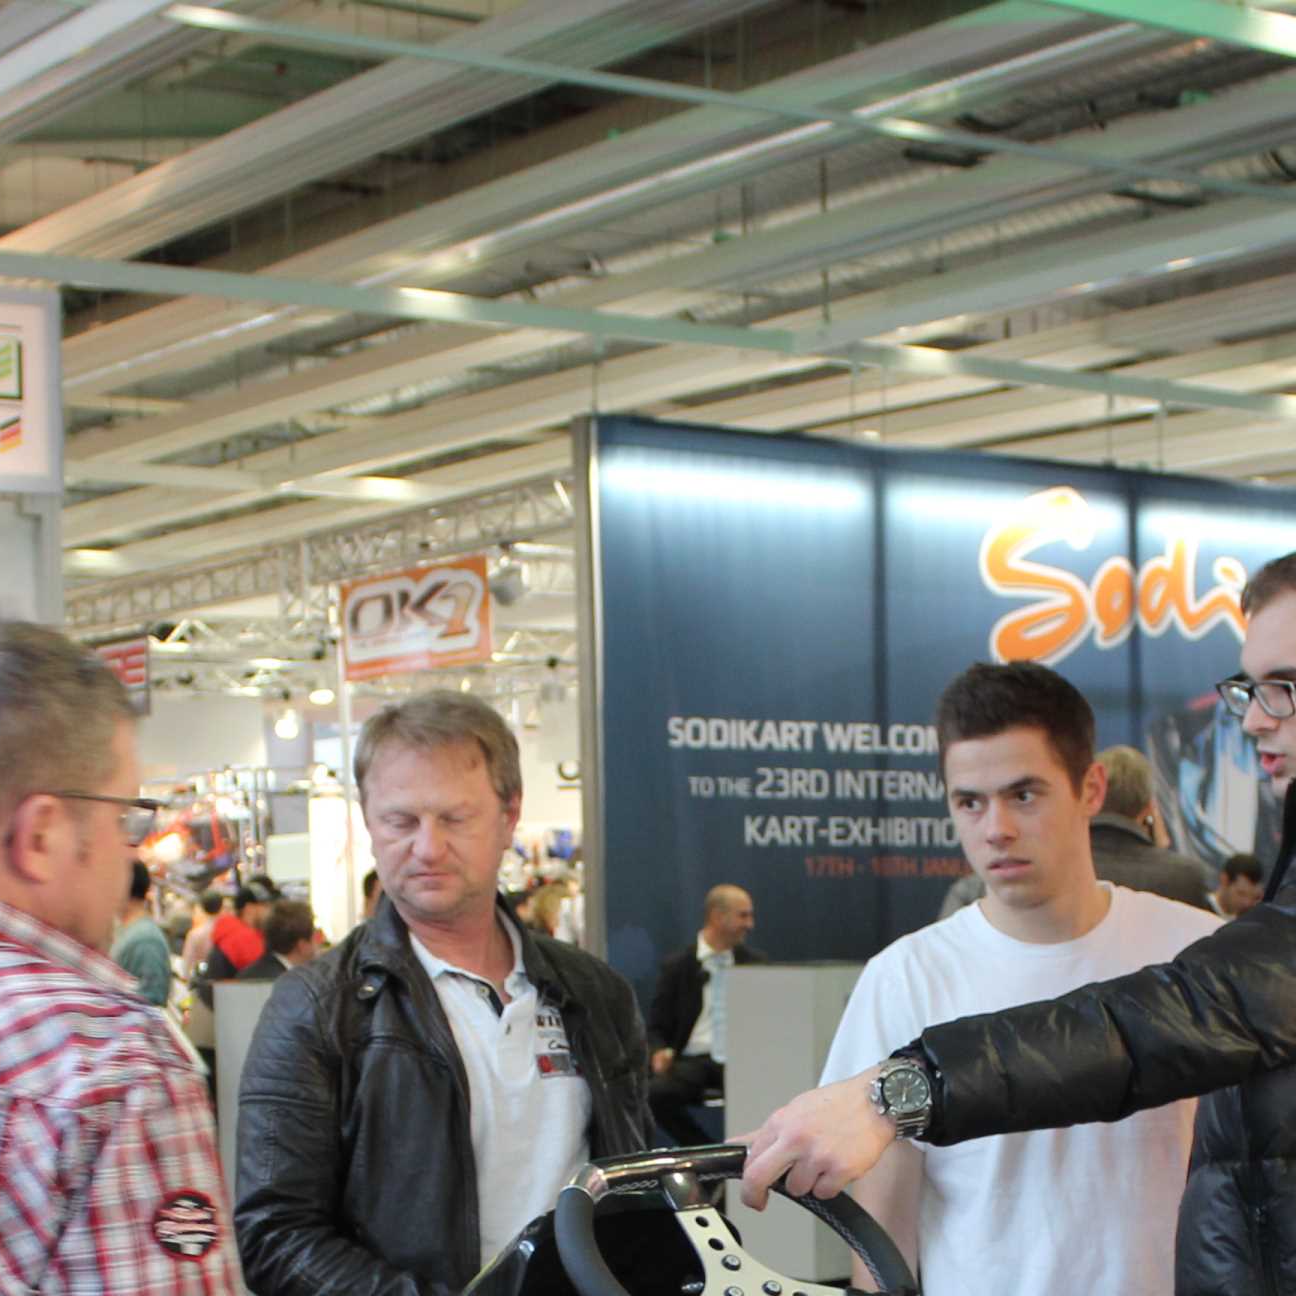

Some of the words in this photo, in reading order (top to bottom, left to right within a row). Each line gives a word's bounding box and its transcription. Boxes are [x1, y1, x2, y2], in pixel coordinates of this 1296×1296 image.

[667, 716, 818, 751] SODIKART
[688, 775, 715, 797] TO
[718, 776, 752, 797] THE
[755, 767, 829, 799] 23RD
